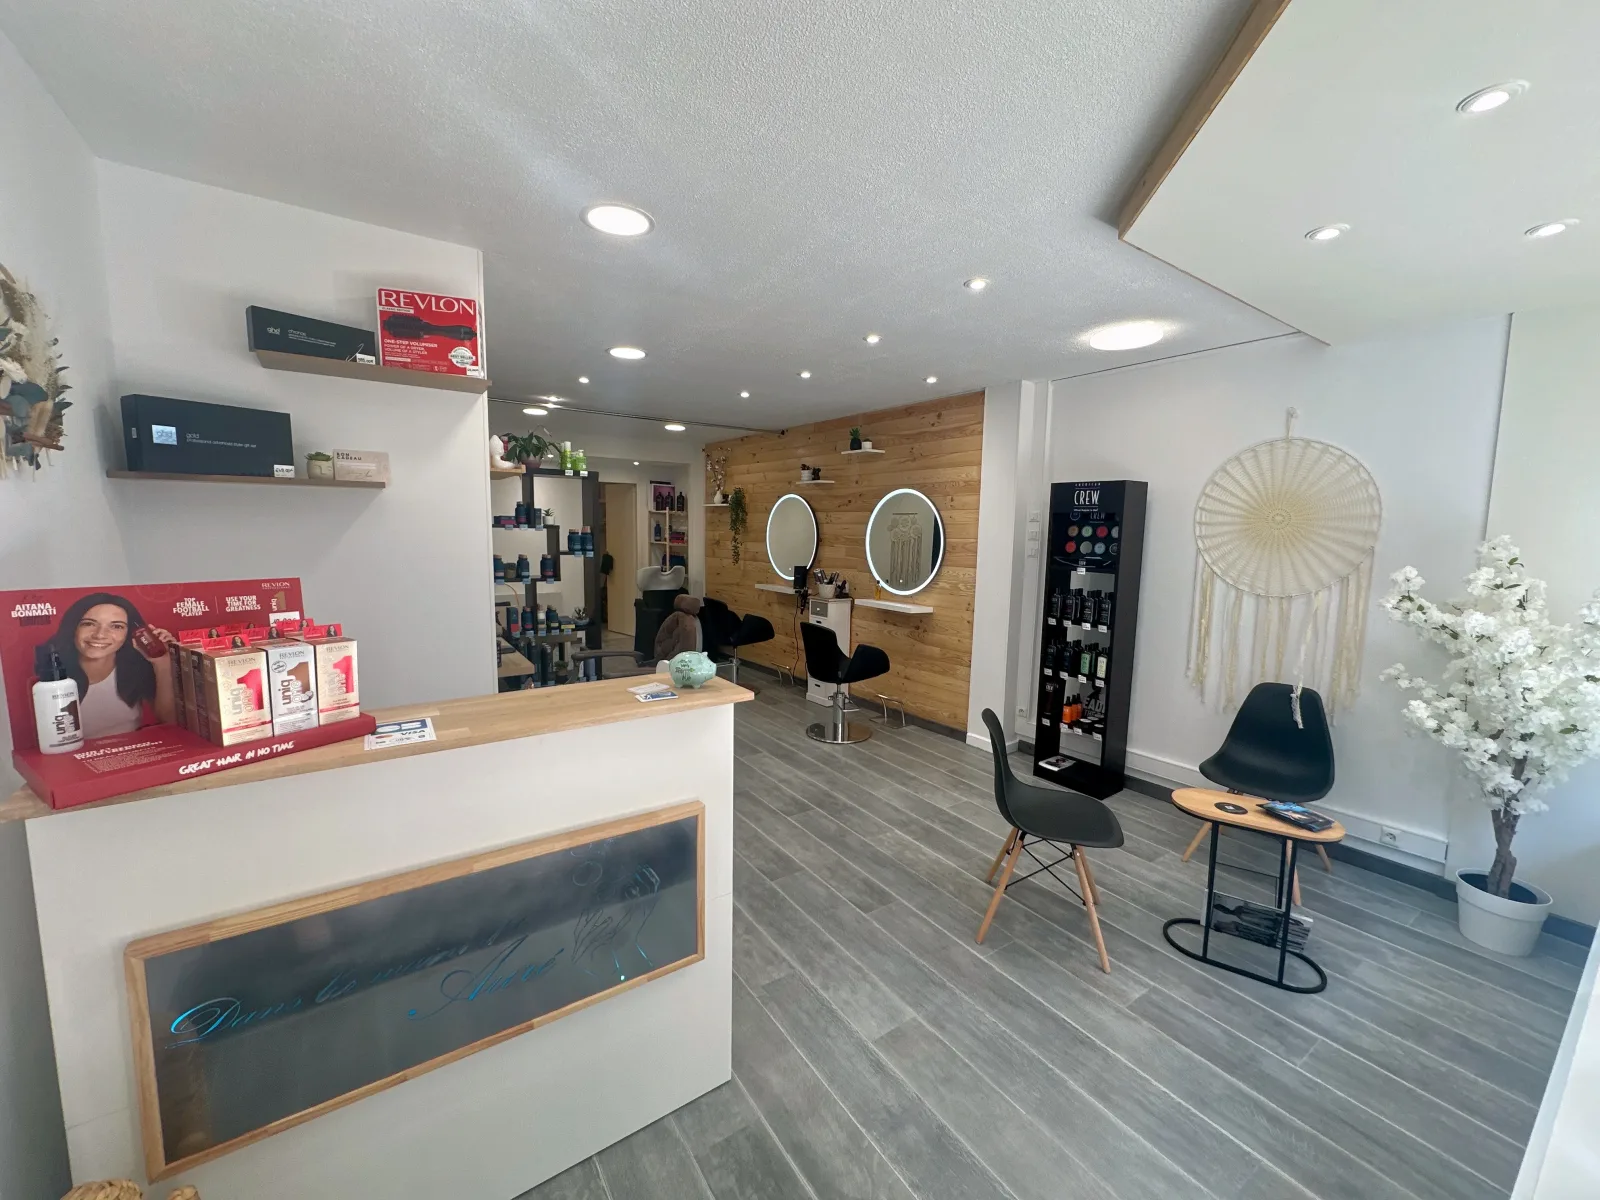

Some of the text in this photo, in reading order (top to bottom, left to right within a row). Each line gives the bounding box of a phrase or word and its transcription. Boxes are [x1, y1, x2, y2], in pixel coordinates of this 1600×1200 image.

[381, 290, 475, 316] REVLON
[1074, 490, 1100, 505] CREW
[15, 603, 52, 611] AITANA
[173, 605, 209, 613] FOOTBALL
[226, 604, 261, 612] GREATNESS
[228, 687, 243, 715] uniq
[278, 679, 294, 705] uniq
[52, 715, 66, 735] uniq
[178, 758, 215, 776] GREAT
[216, 753, 242, 766] HAIR
[245, 750, 255, 759] IN
[257, 747, 270, 757] NO
[272, 741, 294, 753] TIME
